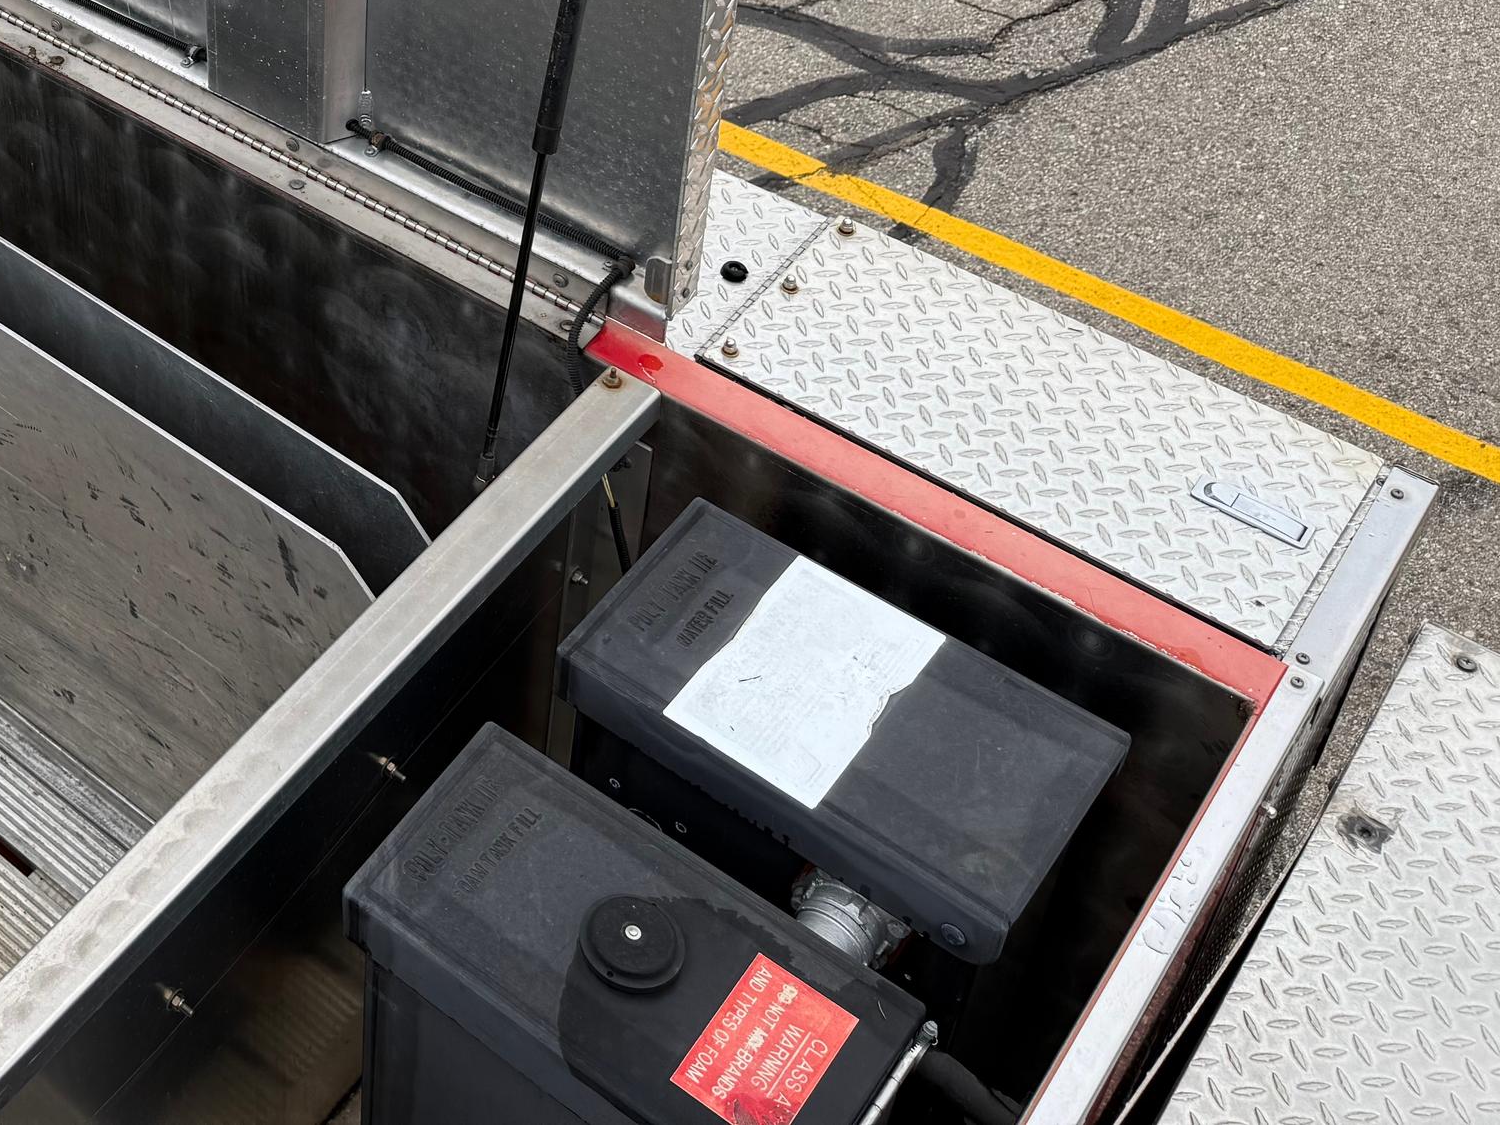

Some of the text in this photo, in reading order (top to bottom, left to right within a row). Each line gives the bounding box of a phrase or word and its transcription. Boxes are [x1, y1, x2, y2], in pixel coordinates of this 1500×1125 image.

[675, 589, 735, 647] WATER FILL
[507, 806, 542, 837] FILL
[685, 964, 773, 1084] AND TYPES OF FOAM
[760, 1002, 786, 1030] NOT
[712, 1049, 754, 1100] BRANDS
[750, 1023, 805, 1091] WARNING
[774, 1039, 829, 1107] CLASS A
